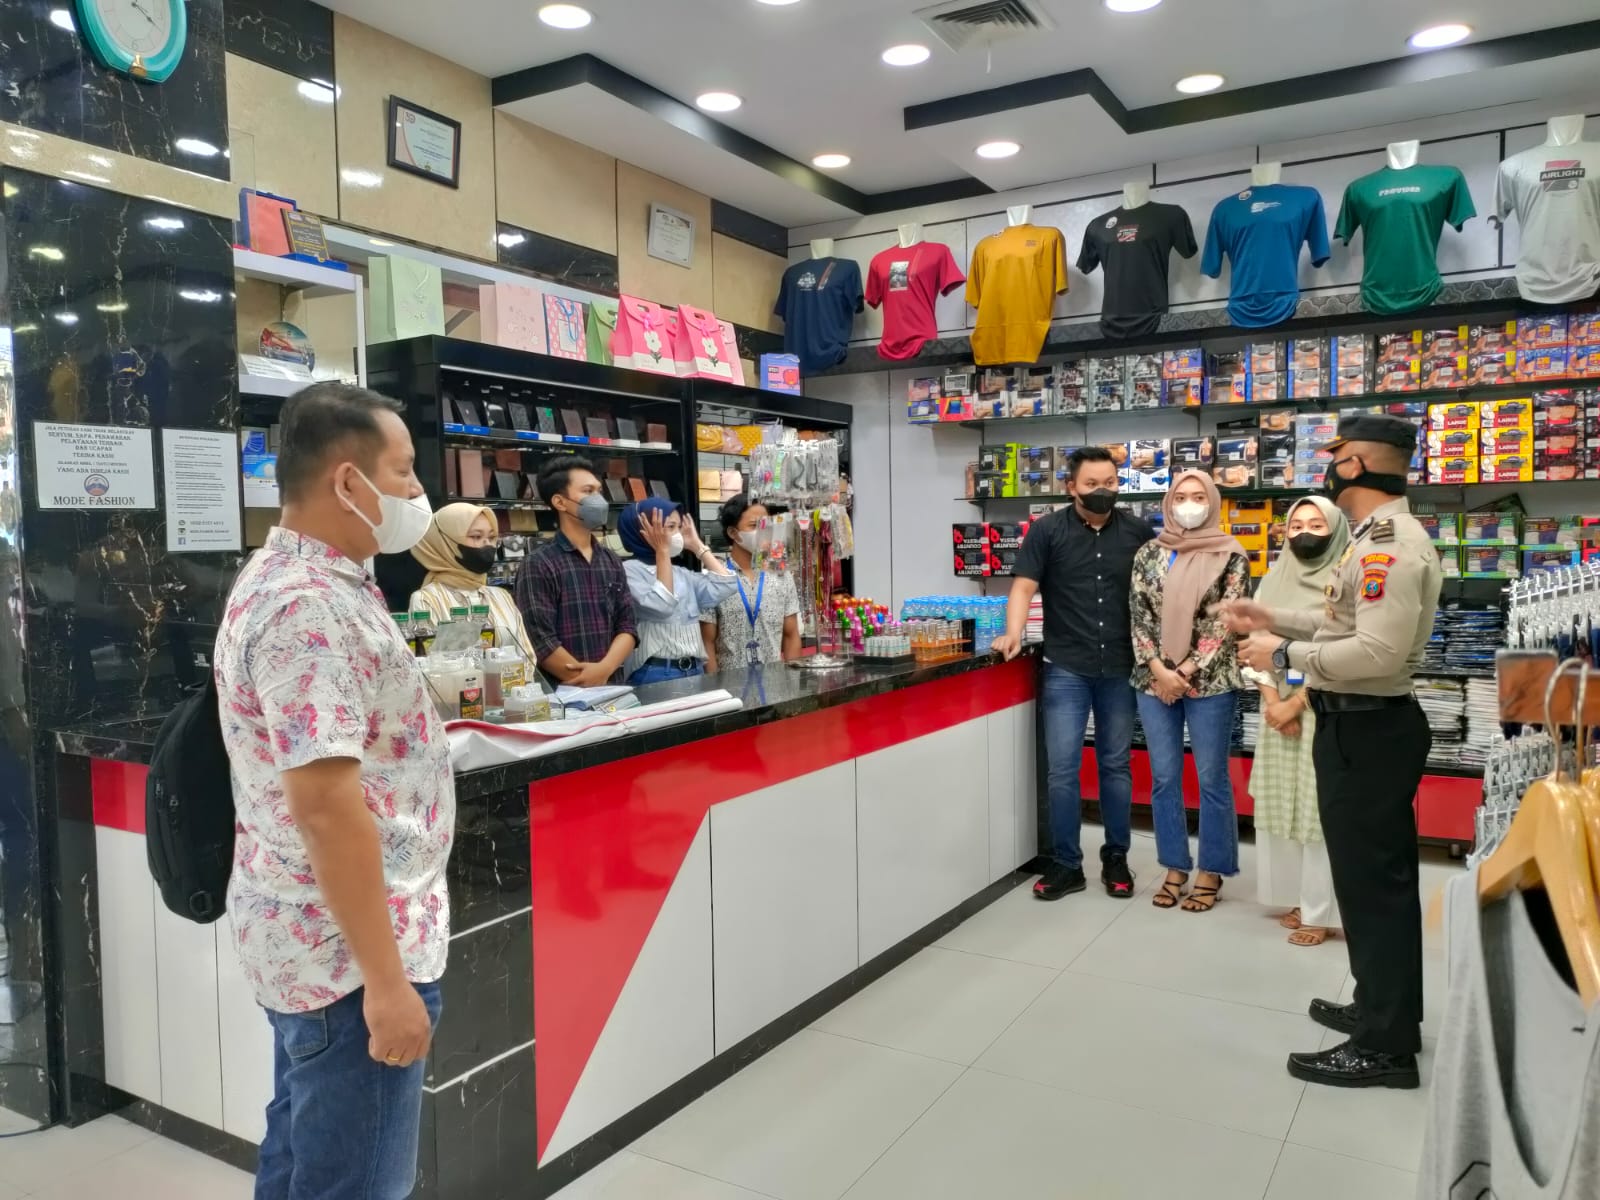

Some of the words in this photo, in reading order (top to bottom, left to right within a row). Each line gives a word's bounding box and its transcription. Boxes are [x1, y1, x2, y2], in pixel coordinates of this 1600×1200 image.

[1542, 170, 1584, 180] AIRLIGHT
[53, 496, 86, 506] MODE
[89, 496, 136, 506] FASHION
